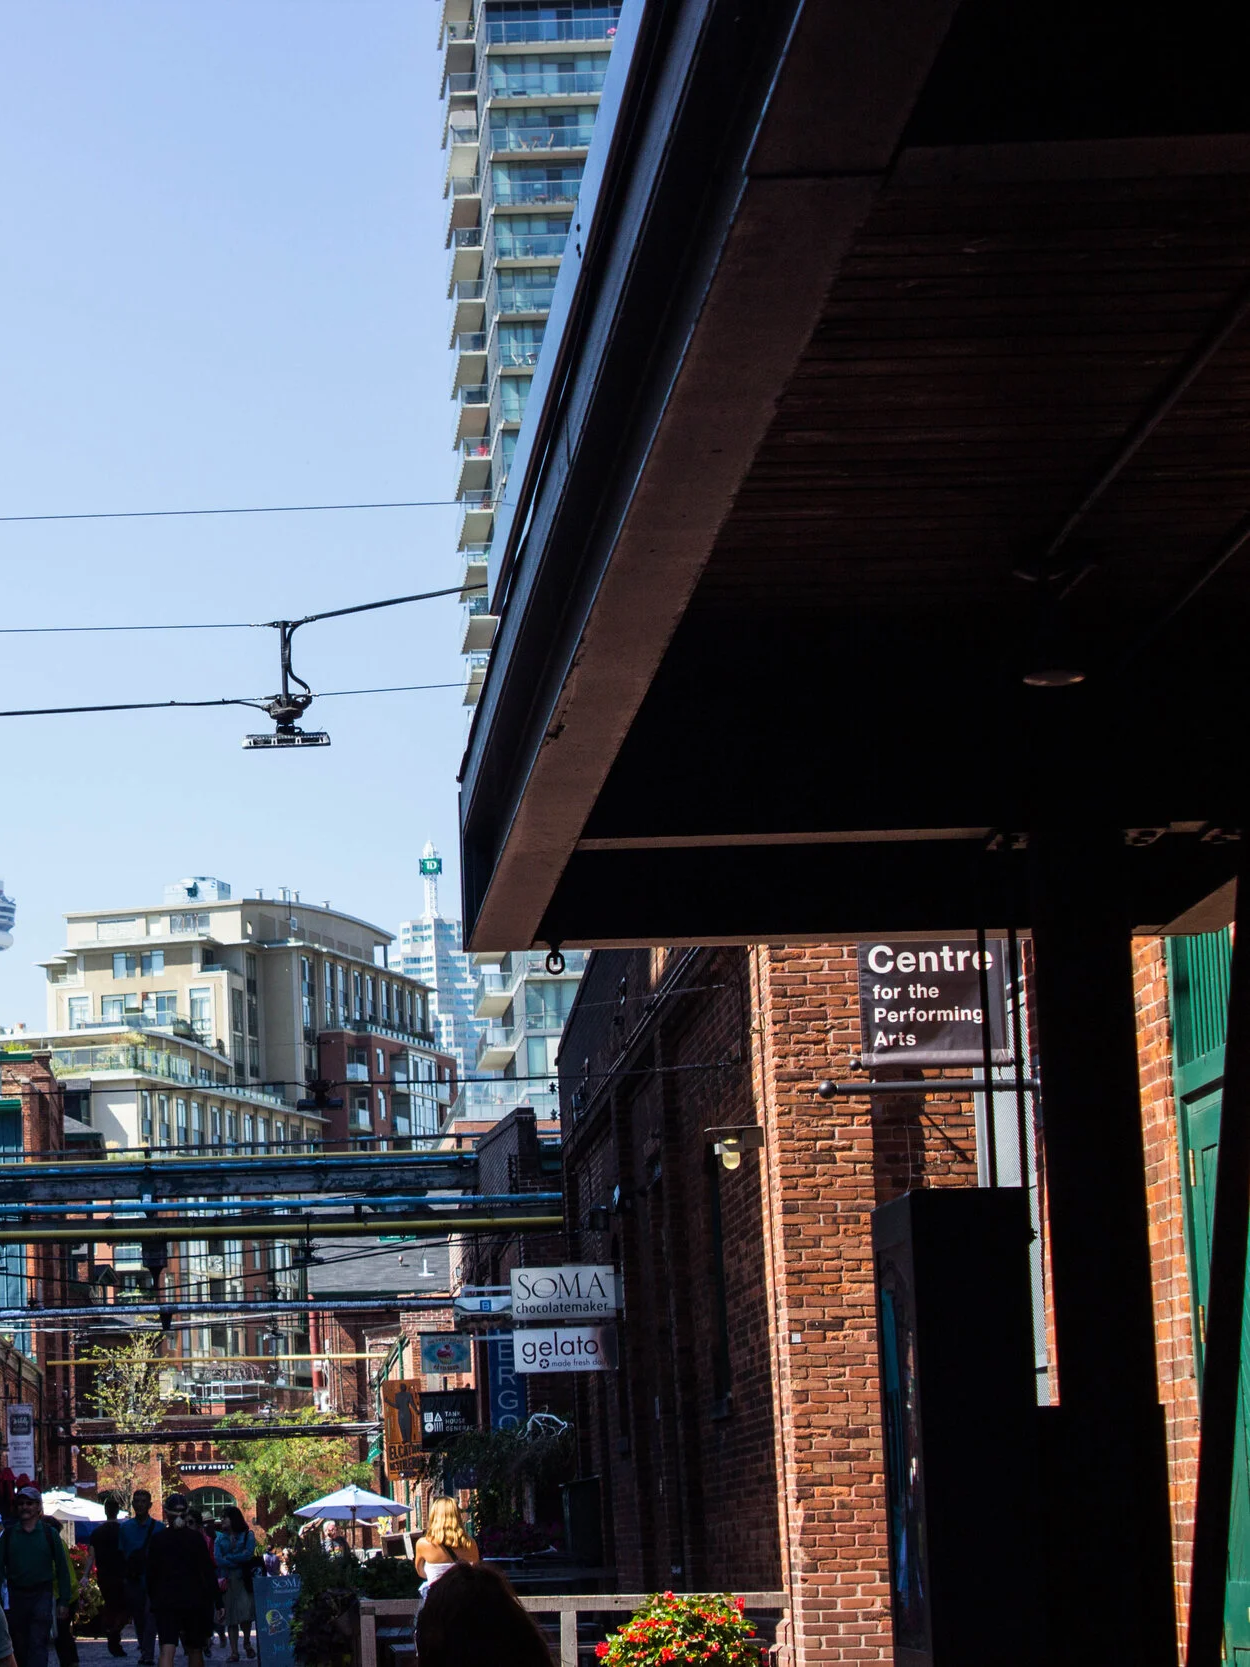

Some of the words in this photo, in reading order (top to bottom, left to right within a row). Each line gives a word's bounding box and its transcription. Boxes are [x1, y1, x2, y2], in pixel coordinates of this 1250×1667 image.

[424, 860, 437, 870] TD
[867, 944, 994, 974] Centre
[872, 984, 902, 1000] for
[908, 983, 940, 999] the
[874, 1006, 984, 1024] Performing
[873, 1031, 917, 1047] Arts
[516, 1271, 609, 1301] SOMA
[515, 1301, 608, 1315] chocolatemaker
[521, 1331, 599, 1365] gelato
[551, 1358, 572, 1368] made
[573, 1358, 591, 1367] fresh
